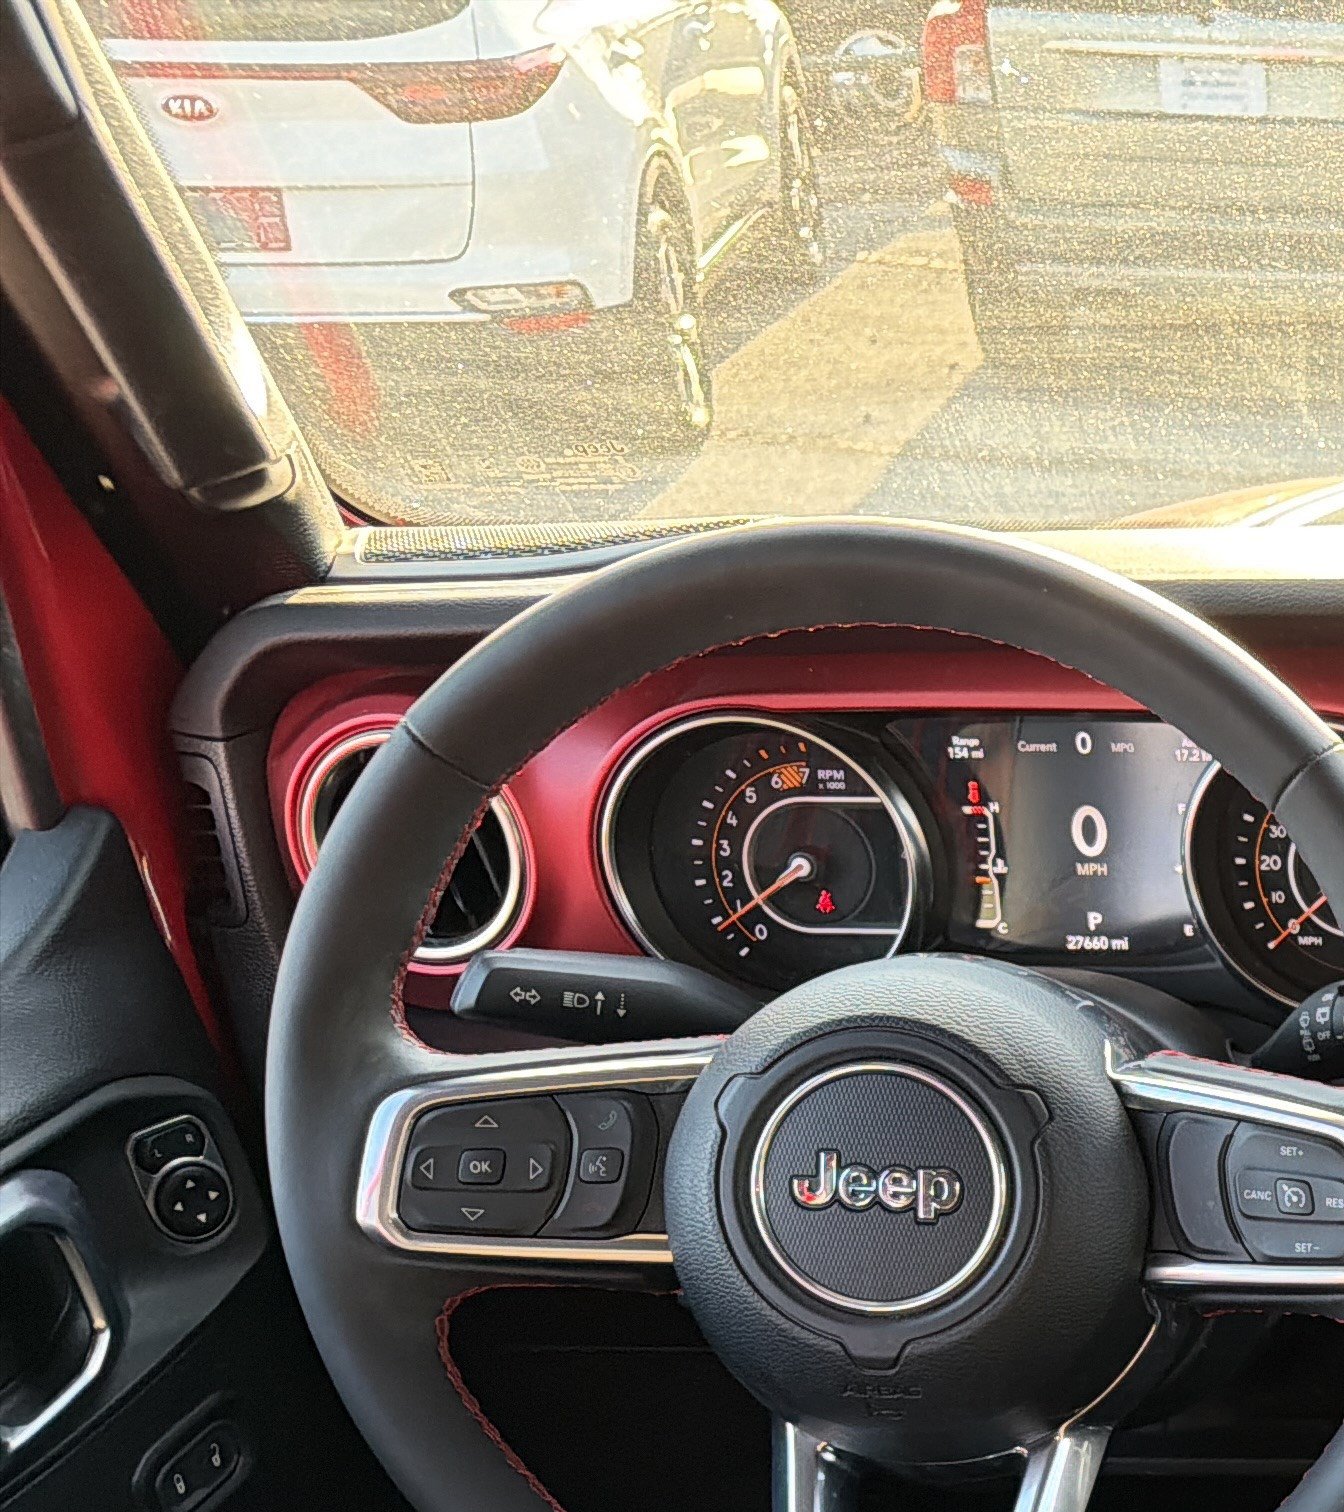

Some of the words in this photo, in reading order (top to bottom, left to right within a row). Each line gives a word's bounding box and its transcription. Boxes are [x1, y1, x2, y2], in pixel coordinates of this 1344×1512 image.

[168, 98, 208, 117] KIA
[951, 735, 979, 748] Range
[1017, 740, 1057, 753] Current
[1075, 731, 1093, 755] 0
[1110, 742, 1135, 753] MPG
[948, 747, 969, 759] 154
[971, 748, 984, 759] mi
[799, 767, 810, 784] 7
[817, 769, 845, 780] RPM
[771, 776, 783, 789] 6
[826, 781, 847, 790] 1000
[745, 787, 757, 804] 5
[989, 802, 1000, 813] H
[1177, 803, 1186, 815] F
[726, 811, 738, 827] 4
[1071, 804, 1108, 857] 0
[1269, 824, 1287, 839] 30
[718, 839, 731, 857] 3
[1076, 862, 1108, 876] MPH
[1260, 855, 1282, 872] 20
[721, 871, 733, 887] 2
[1270, 890, 1286, 904] 10
[997, 921, 1009, 935] C
[1086, 911, 1102, 931] P
[754, 923, 768, 940] 0
[1184, 924, 1194, 936] E
[1066, 935, 1109, 950] 27660
[1111, 936, 1129, 950] mi
[1297, 935, 1323, 947] MPH
[469, 1160, 492, 1174] OK
[791, 1150, 963, 1222] Jeep
[1243, 1189, 1272, 1201] CANC
[1325, 1197, 1344, 1209] RES
